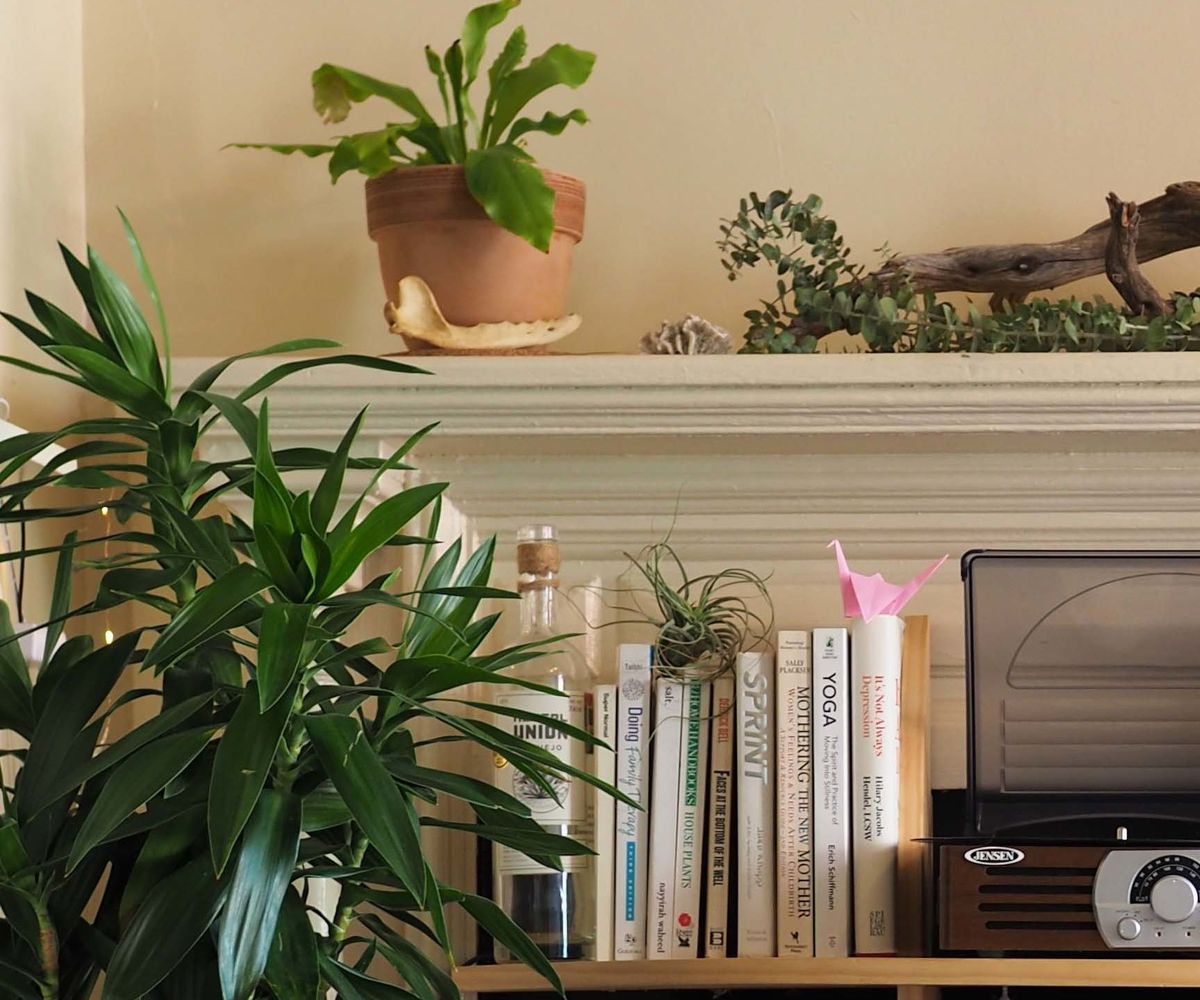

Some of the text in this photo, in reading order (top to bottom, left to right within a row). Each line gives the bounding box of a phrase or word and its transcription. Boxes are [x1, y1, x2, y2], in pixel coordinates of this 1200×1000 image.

[785, 659, 804, 667] SALLY
[602, 692, 610, 713] Super
[625, 707, 644, 742] Doing
[664, 686, 674, 707] salt.
[743, 670, 768, 785] SPRINT
[822, 672, 837, 727] YOGA
[859, 675, 873, 738] Depression
[873, 675, 886, 757] It's Not Always
[619, 746, 643, 787] Family
[717, 728, 729, 743] BELL
[822, 735, 831, 763] Moving
[685, 729, 699, 806] HANDBOOKS
[823, 781, 831, 809] Stillness
[830, 736, 839, 825] The Spirit and Practice of
[712, 770, 731, 886] FACES AT THE BOTTOM OF THE WELL
[797, 686, 811, 919] MOTHERING THE NEW MOTHER
[862, 776, 873, 842] Hendel, LCSW
[873, 776, 885, 837] Hilary Jacobs
[681, 812, 695, 889] HOUSE PLANTS
[827, 844, 836, 910] Erich Schiffmann
[973, 850, 1015, 861] JENSEN
[656, 882, 666, 953] nayyirah waheed
